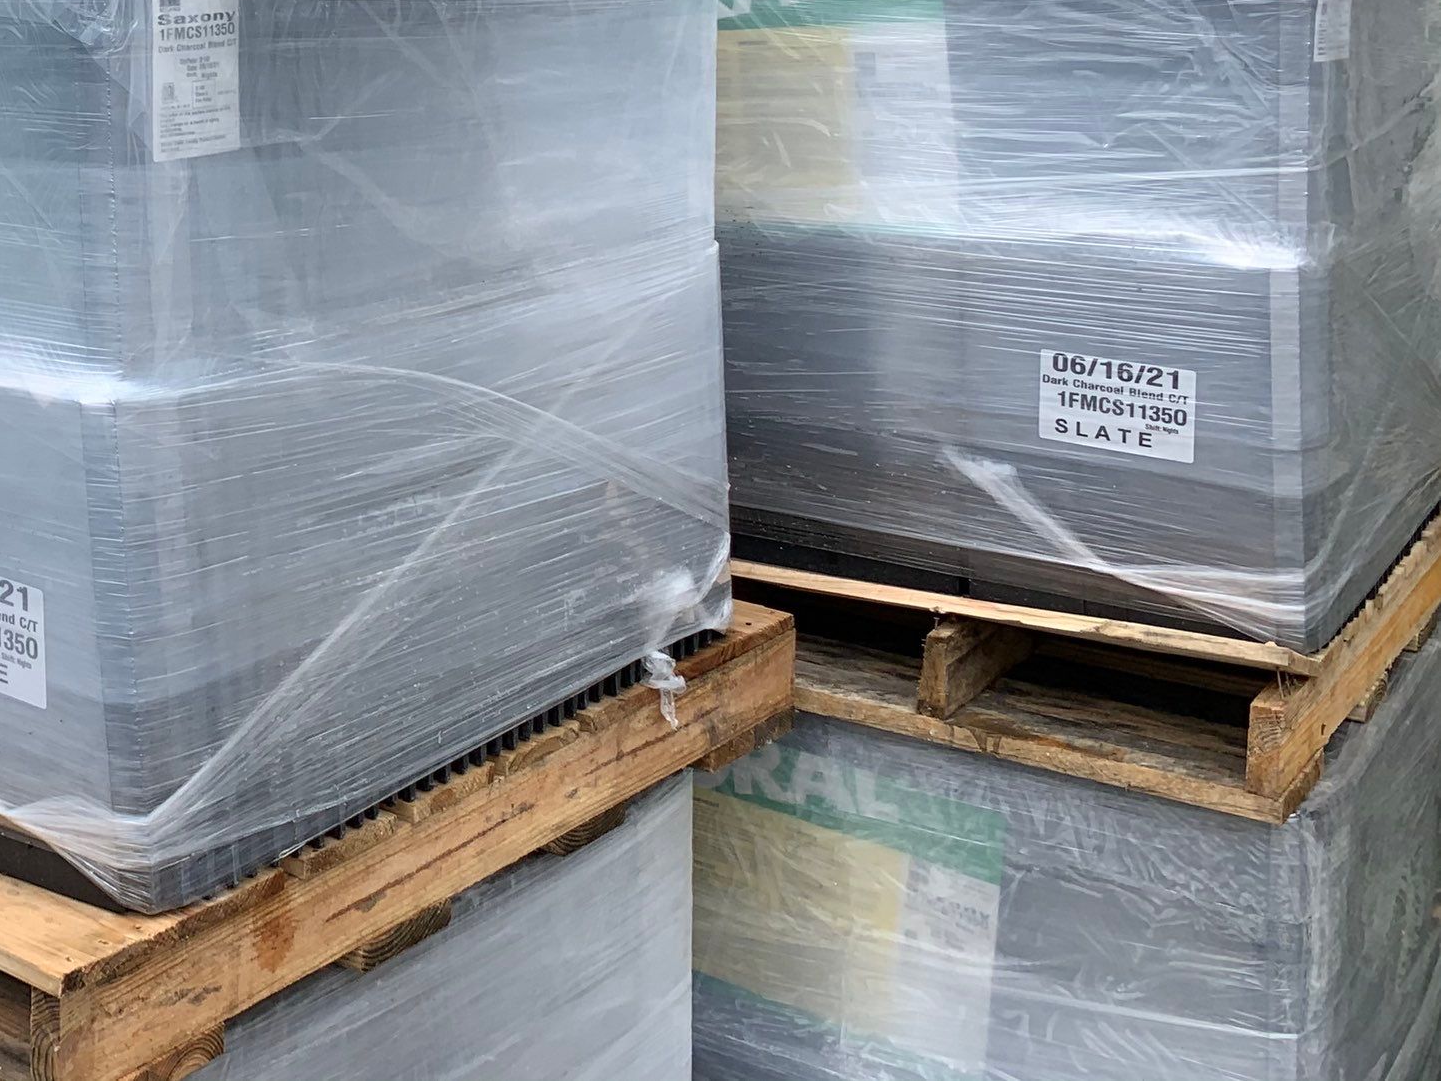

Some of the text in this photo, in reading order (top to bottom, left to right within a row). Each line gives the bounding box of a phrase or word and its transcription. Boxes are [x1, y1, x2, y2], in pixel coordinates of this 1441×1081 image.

[157, 10, 236, 26] Saxony
[159, 22, 235, 41] 1FMCS11350
[158, 44, 174, 53] Dark
[176, 42, 206, 52] Charcoal
[1052, 352, 1179, 390] 06/16/21
[1042, 374, 1189, 405] Dark Charcoal Blend C/T
[1058, 390, 1188, 426] 1FMCS11350
[1055, 418, 1153, 448] SLATE
[19, 616, 39, 633] C/T
